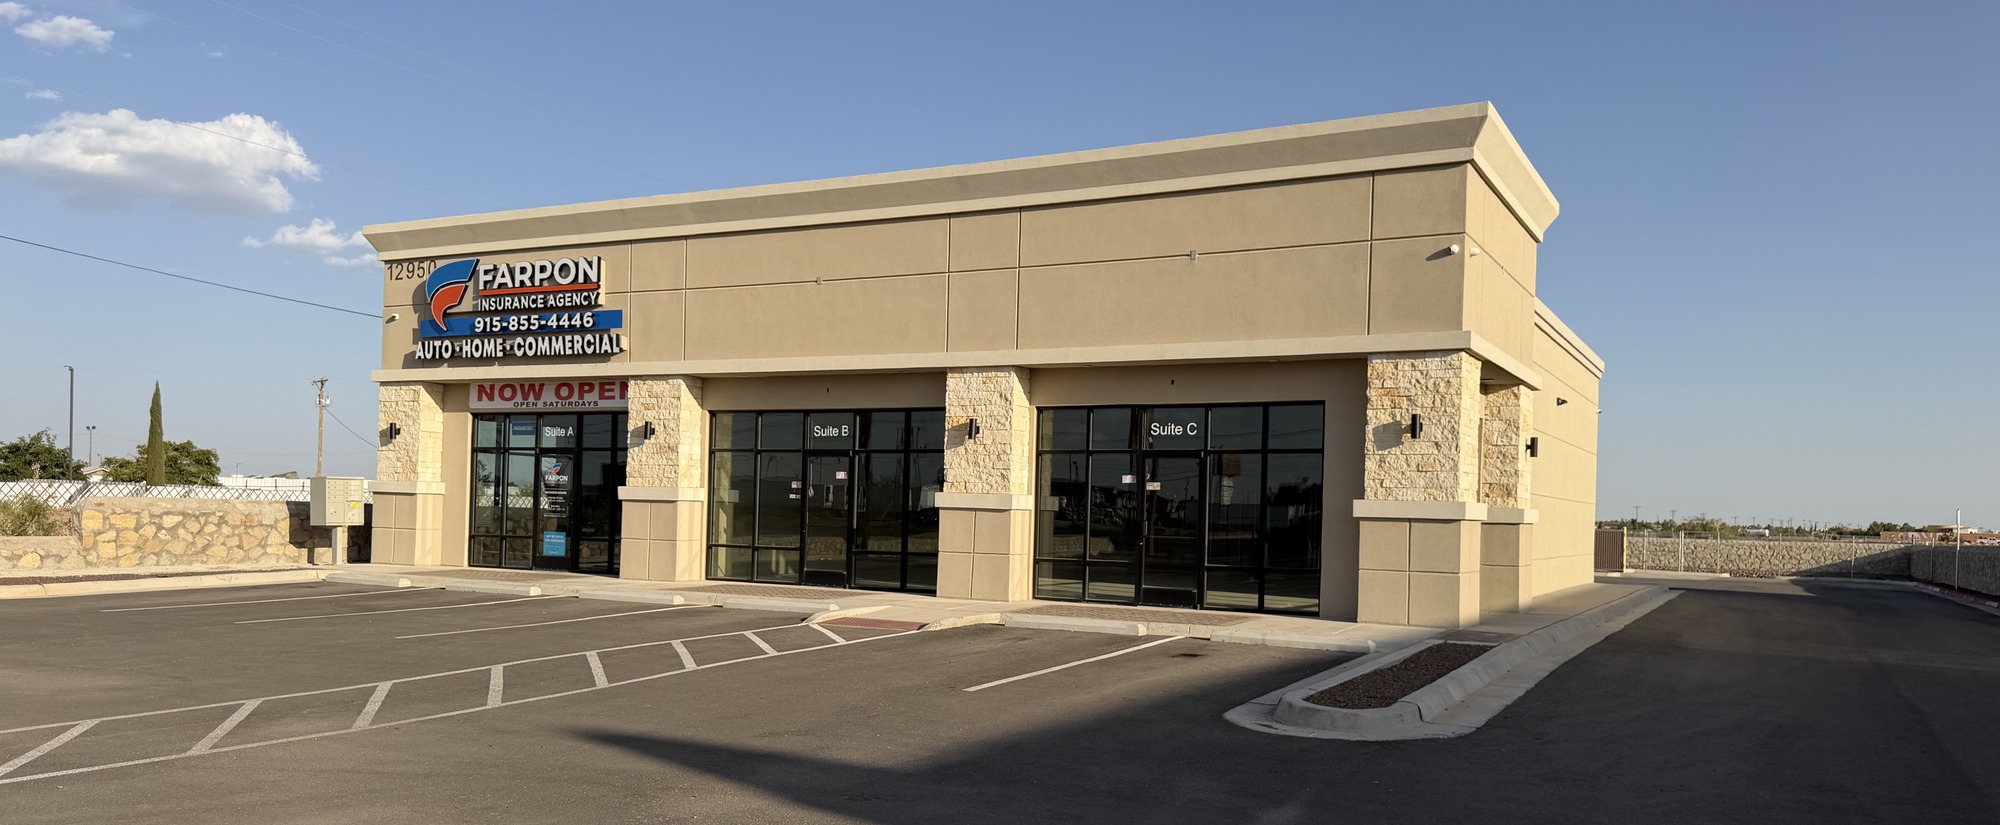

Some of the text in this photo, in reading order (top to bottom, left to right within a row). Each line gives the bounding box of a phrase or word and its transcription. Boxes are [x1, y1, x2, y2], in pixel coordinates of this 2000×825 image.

[387, 260, 436, 280] 12950
[478, 256, 600, 290] FARPON
[478, 292, 598, 311] INSURANCE AGENCY
[474, 312, 594, 333] 915-855-4446
[415, 333, 621, 360] AUTO HOME COMMERCIAL
[477, 382, 545, 402] NOW
[542, 400, 599, 408] SATURDAYS
[544, 426, 566, 437] Suite
[567, 426, 574, 437] A
[813, 425, 850, 437] Suite B
[1150, 422, 1198, 436] Suite C
